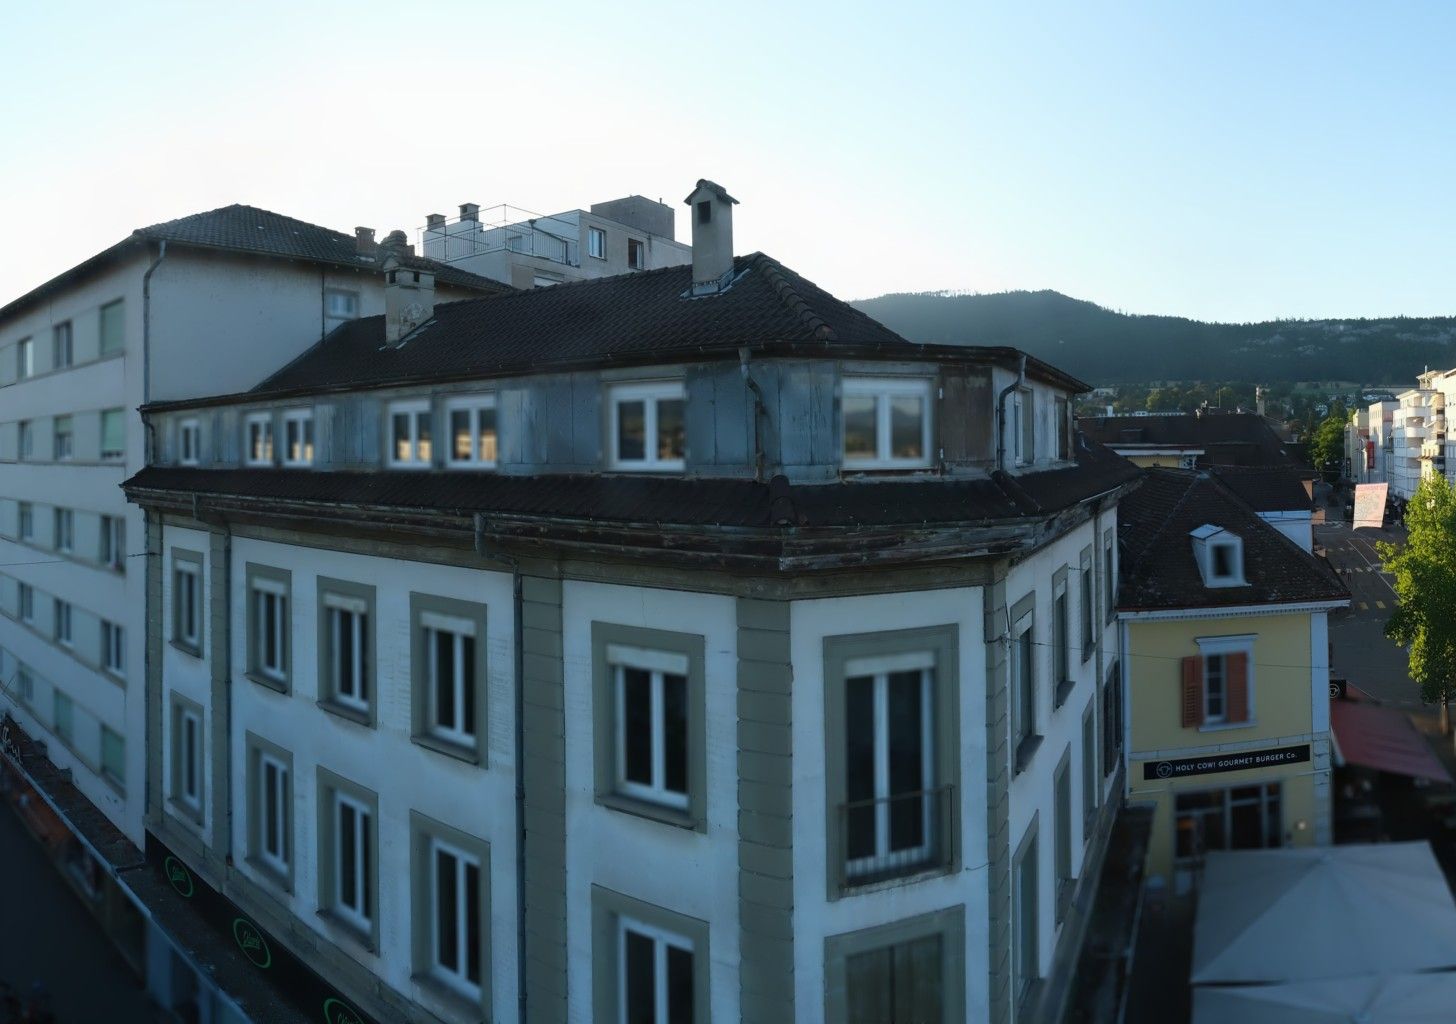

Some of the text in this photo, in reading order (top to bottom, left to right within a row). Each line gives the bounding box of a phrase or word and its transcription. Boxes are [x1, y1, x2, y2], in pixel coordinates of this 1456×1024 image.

[1175, 764, 1194, 772] HOLY
[1197, 762, 1216, 771] COW!
[1218, 757, 1253, 768] GOURMET
[1256, 753, 1284, 763] BURGER
